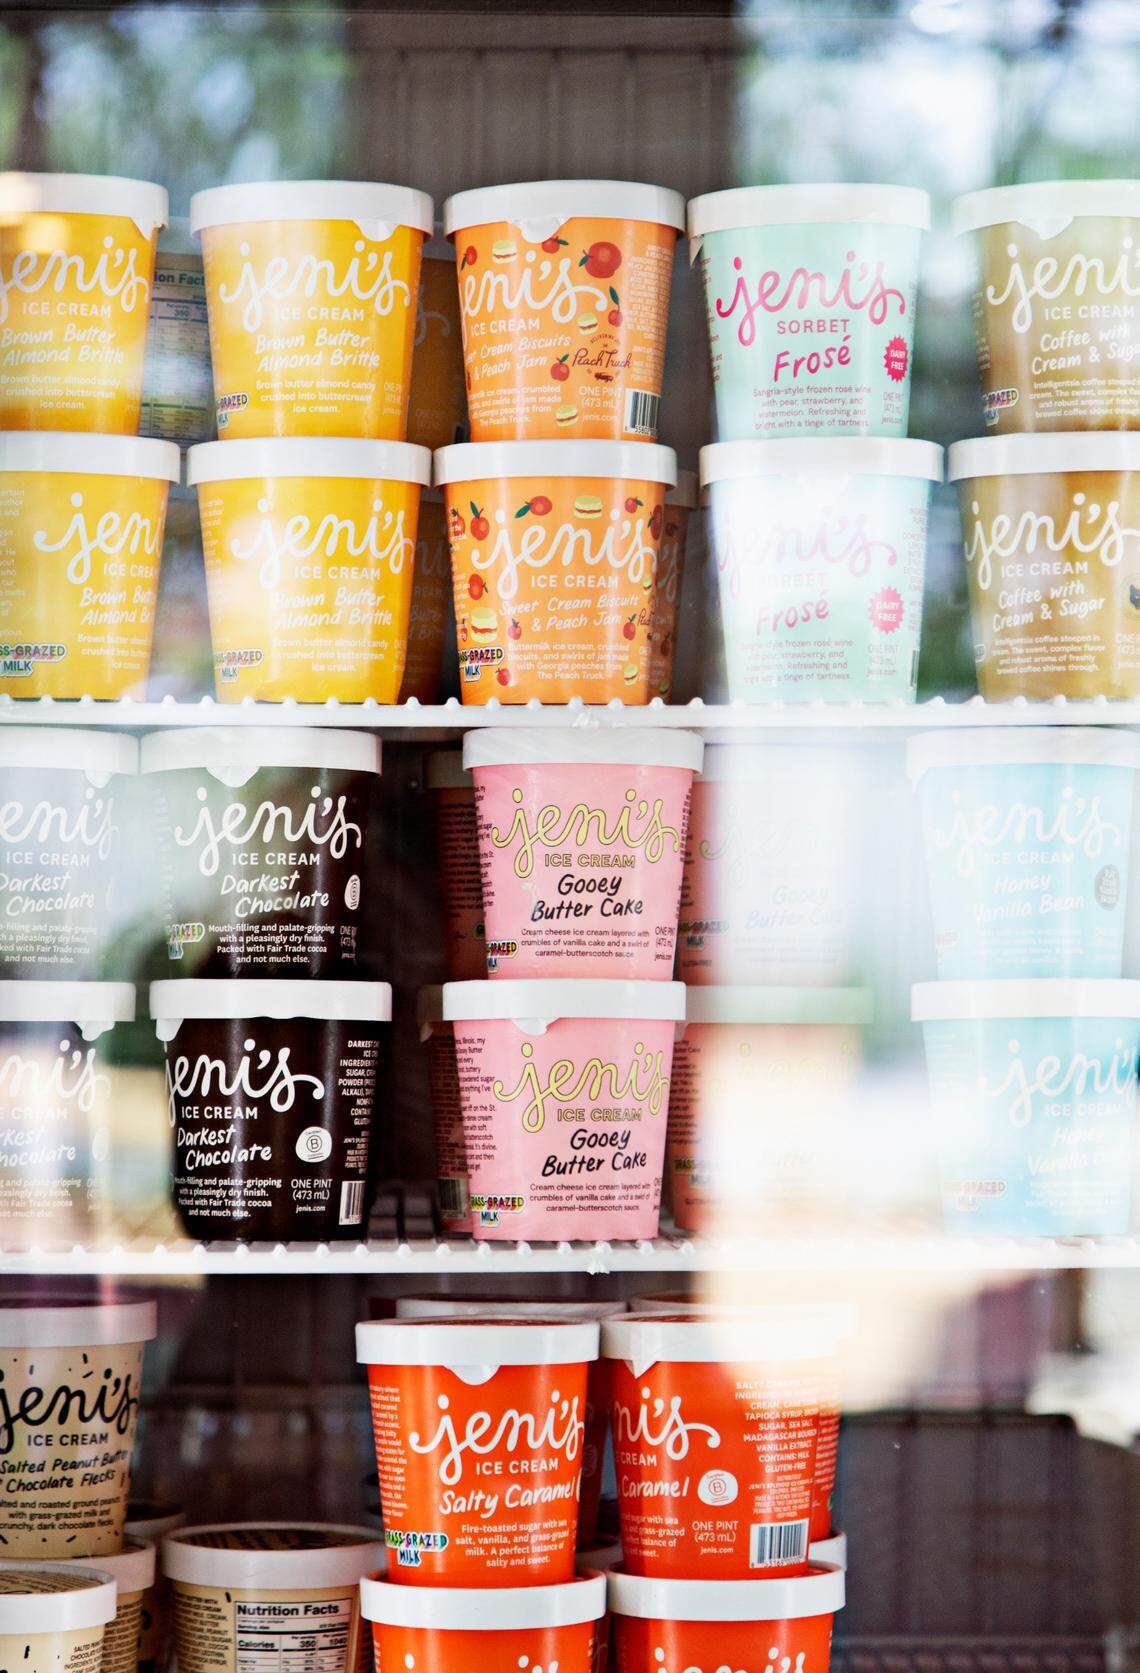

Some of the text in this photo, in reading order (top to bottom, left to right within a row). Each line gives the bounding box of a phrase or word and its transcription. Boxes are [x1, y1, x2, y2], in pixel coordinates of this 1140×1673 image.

[219, 240, 410, 332] jeni's
[716, 251, 905, 346] jeni's
[23, 302, 112, 319] ICE CREAM
[274, 308, 364, 321] ICE CREAM
[1044, 306, 1134, 320] ICE CREAM
[471, 318, 541, 337] ICE CREAM
[777, 319, 850, 334] SORBET
[255, 328, 370, 354] Brown Butter
[1040, 331, 1091, 352] Coffee
[257, 352, 323, 372] Almond
[572, 347, 602, 368] Peach
[606, 350, 632, 369] Truck
[773, 335, 851, 382] Frosé
[1032, 353, 1082, 375] Cream
[806, 385, 832, 394] frozen
[231, 500, 414, 589] jeni's
[471, 509, 657, 599] jeni's
[104, 564, 125, 576] ICE
[294, 567, 380, 580] ICE CREAM
[1002, 562, 1088, 577] ICE CREAM
[531, 575, 619, 589] ICE CREAM
[80, 587, 125, 606] Brown
[335, 587, 384, 607] Butter
[999, 580, 1085, 609] Coffee with
[547, 596, 591, 612] Cream
[80, 607, 136, 625] Almond
[546, 612, 621, 631] Peach Jam
[993, 597, 1105, 632] Cream & Sugar
[4, 661, 31, 671] MILK
[175, 786, 362, 876] jeni's
[492, 789, 679, 878] jeni's
[931, 787, 1120, 876] jeni's
[7, 852, 90, 865] ICE CREAM
[232, 854, 320, 865] ICE CREAM
[545, 854, 635, 868] ICE CREAM
[220, 871, 300, 896] Darkest
[558, 874, 622, 896] Gooey
[993, 875, 1052, 893] Honey
[7, 893, 95, 916] Chocolate
[234, 893, 329, 918] Chocolate
[531, 898, 643, 922] Butter Cake
[209, 924, 335, 934] Mouth-filling and palate-gripping
[521, 929, 543, 937] Cream
[545, 928, 570, 936] cheese
[573, 928, 585, 936] ice
[246, 934, 287, 944] pleasingly
[289, 935, 302, 943] dry
[217, 945, 244, 953] Packed
[285, 945, 306, 953] Trade
[236, 955, 251, 963] and
[269, 955, 291, 963] much
[494, 1042, 670, 1133] jeni's
[182, 1107, 257, 1119] ICE CREAM
[557, 1108, 642, 1121] ICE CREAM
[177, 1125, 236, 1147] Darkest
[570, 1128, 631, 1150] Gooey
[186, 1145, 272, 1170] Chocolate
[542, 1152, 647, 1177] Butter Cake
[218, 1178, 281, 1187] palate-gripping
[291, 1179, 332, 1188] ONE PINT
[530, 1183, 554, 1191] Cream
[557, 1183, 583, 1191] cheese
[229, 1188, 269, 1197] dry finish.
[293, 1189, 329, 1200] (473 mL)
[209, 1198, 222, 1206] Fair
[224, 1198, 245, 1206] Trade
[296, 1205, 325, 1213] jenis.com
[211, 1209, 230, 1217] much
[232, 1209, 251, 1217] else.
[28, 1433, 108, 1446] ICE CREAM
[408, 1390, 584, 1485] jeni's
[0, 1458, 99, 1474] Salted Peanut
[476, 1459, 558, 1475] ICE CREAM
[6, 1469, 116, 1492] Chocolate Flecks
[622, 1476, 690, 1498] Caramel
[38, 1500, 71, 1508] roasted
[439, 1477, 574, 1518] Salty Caramel
[29, 1510, 82, 1521] grass-grazed
[647, 1516, 663, 1524] with
[37, 1522, 54, 1530] dark
[462, 1522, 541, 1534] Fire-toasted sugar
[692, 1521, 738, 1530] ONE PINT
[456, 1534, 528, 1545] salt, and
[670, 1538, 676, 1547] of
[695, 1532, 735, 1542] (473 mL)
[400, 1551, 419, 1562] MILK
[465, 1547, 488, 1555] milk.
[499, 1545, 529, 1556] perfect
[701, 1547, 734, 1555] jenis.com
[487, 1557, 525, 1568] salty and
[238, 1604, 339, 1615] Nutrition Facts
[238, 1640, 274, 1648] Calories
